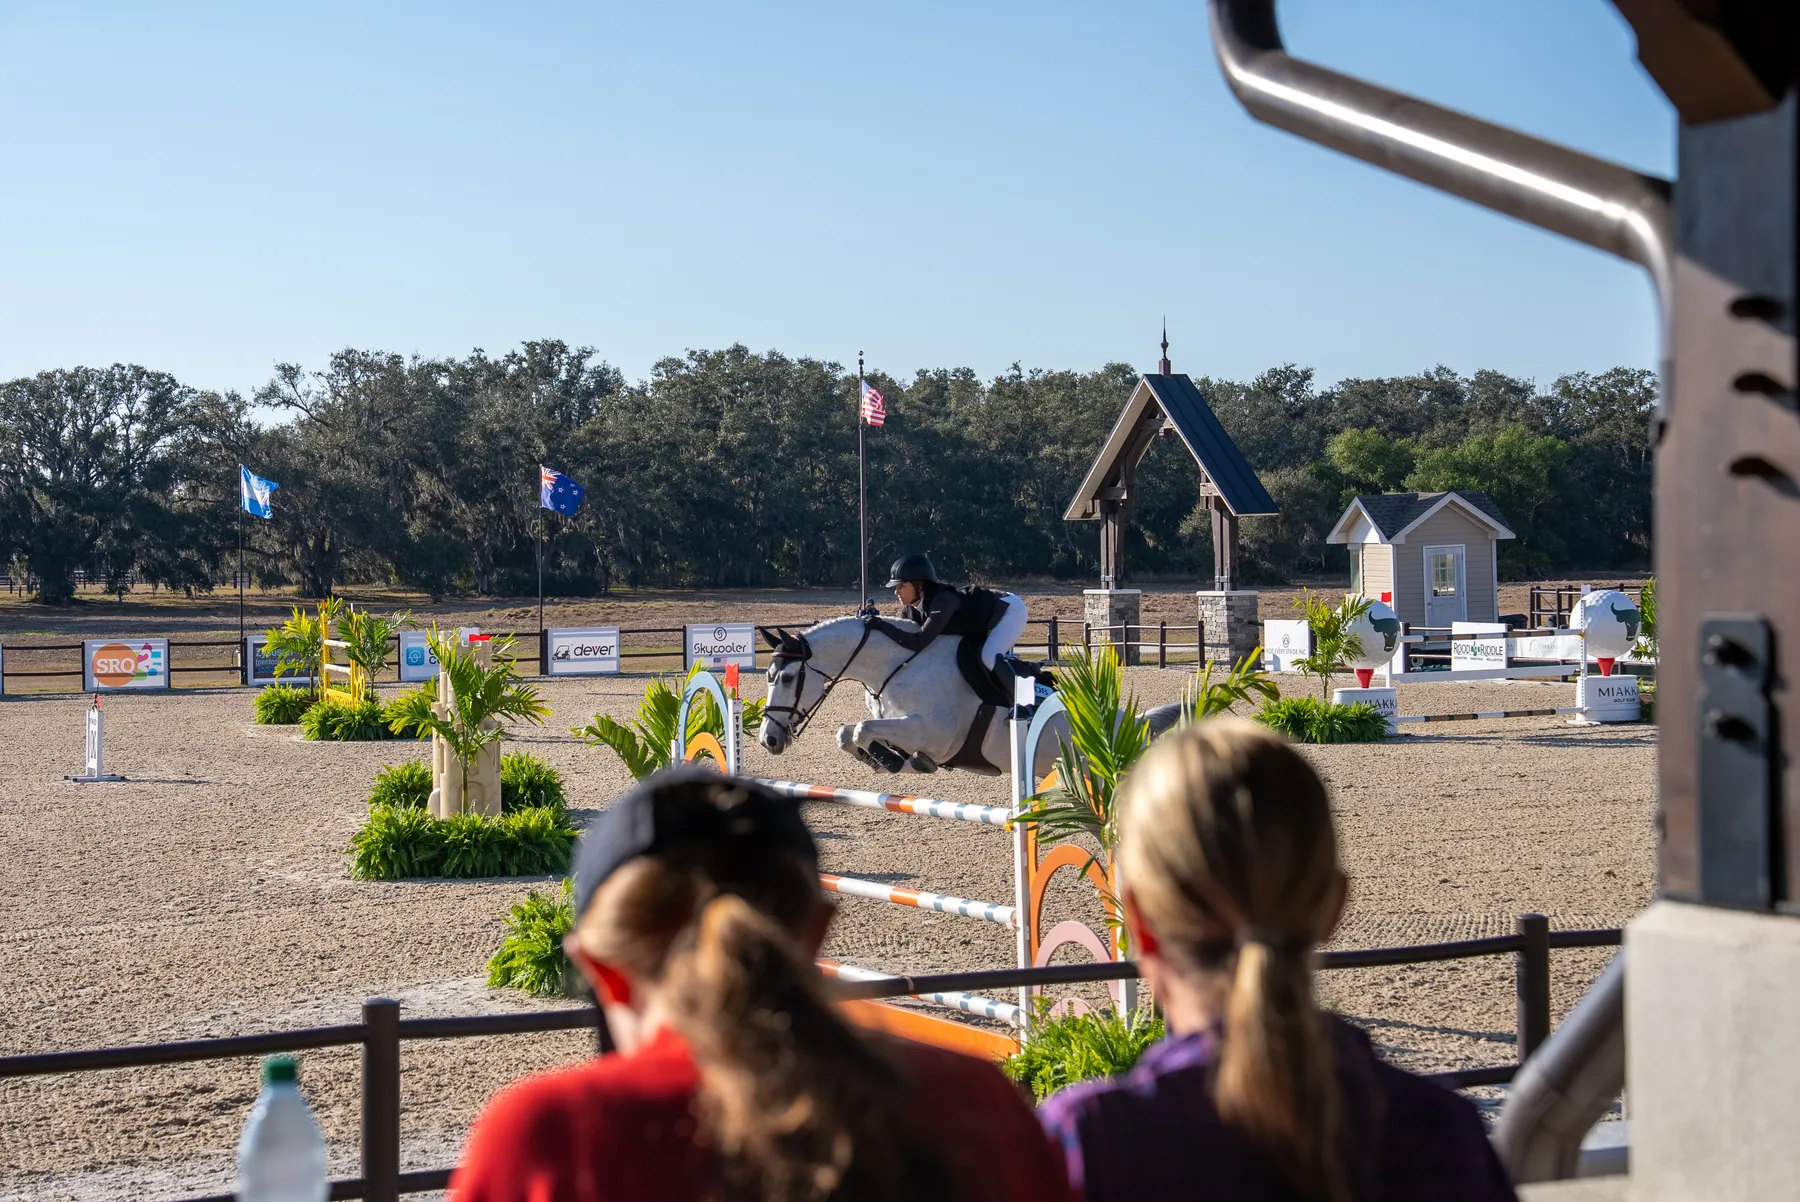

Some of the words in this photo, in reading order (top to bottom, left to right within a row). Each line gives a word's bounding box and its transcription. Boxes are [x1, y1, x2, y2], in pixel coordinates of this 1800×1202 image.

[573, 643, 615, 657] dever
[693, 642, 747, 657] Skycooler
[1453, 642, 1470, 656] ROOD
[1480, 643, 1503, 657] RIDDLE
[96, 657, 137, 676] SRQ
[1598, 686, 1638, 698] MIAKK
